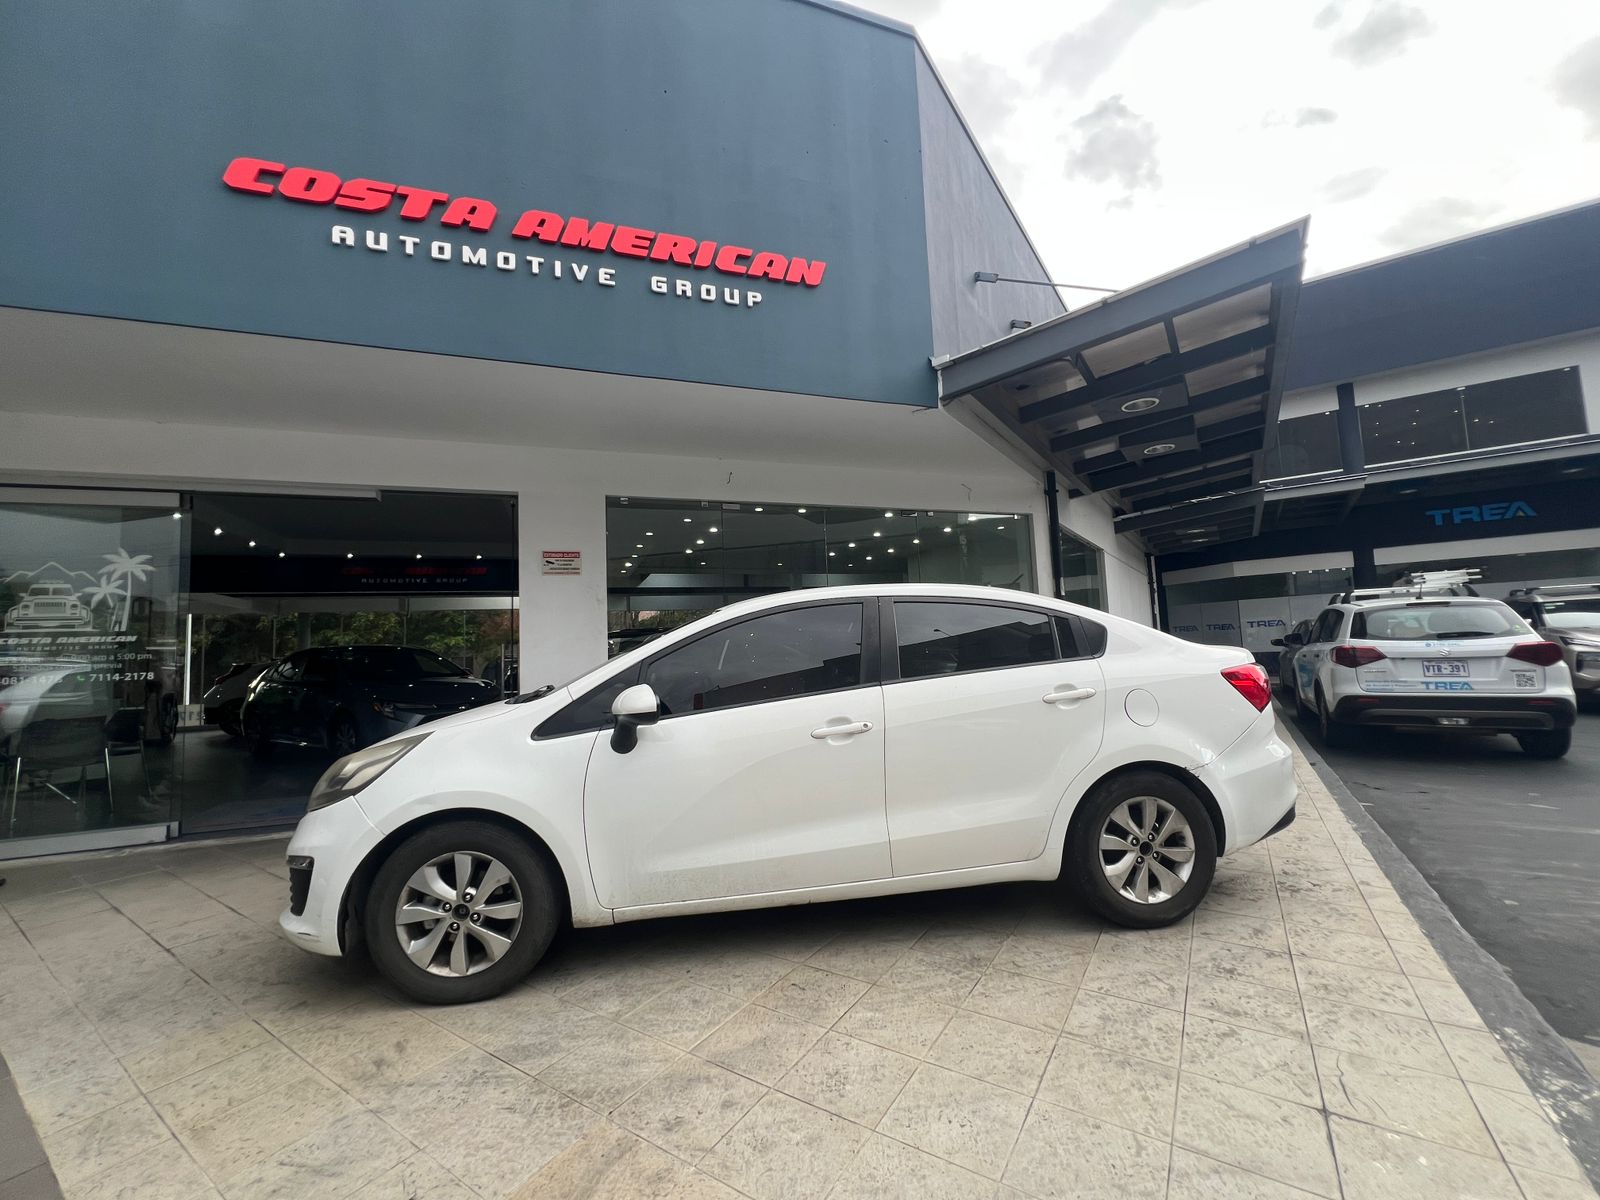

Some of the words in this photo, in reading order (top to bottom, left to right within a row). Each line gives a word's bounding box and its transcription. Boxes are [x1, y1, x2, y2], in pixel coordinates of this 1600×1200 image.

[222, 157, 498, 233] COSTA
[511, 209, 826, 287] AMERICAN
[331, 224, 617, 287] AUTOMOTIVE
[650, 275, 764, 307] GROUP
[1425, 501, 1537, 526] TREA
[1206, 623, 1236, 631] TREA
[1247, 619, 1286, 628] TREA
[56, 635, 138, 644] AMERICAN
[117, 652, 136, 661] 5:00
[137, 652, 153, 662] pm
[1425, 664, 1467, 673] VTR-391
[89, 672, 155, 682] 7114-2178
[1421, 681, 1474, 690] TREA
